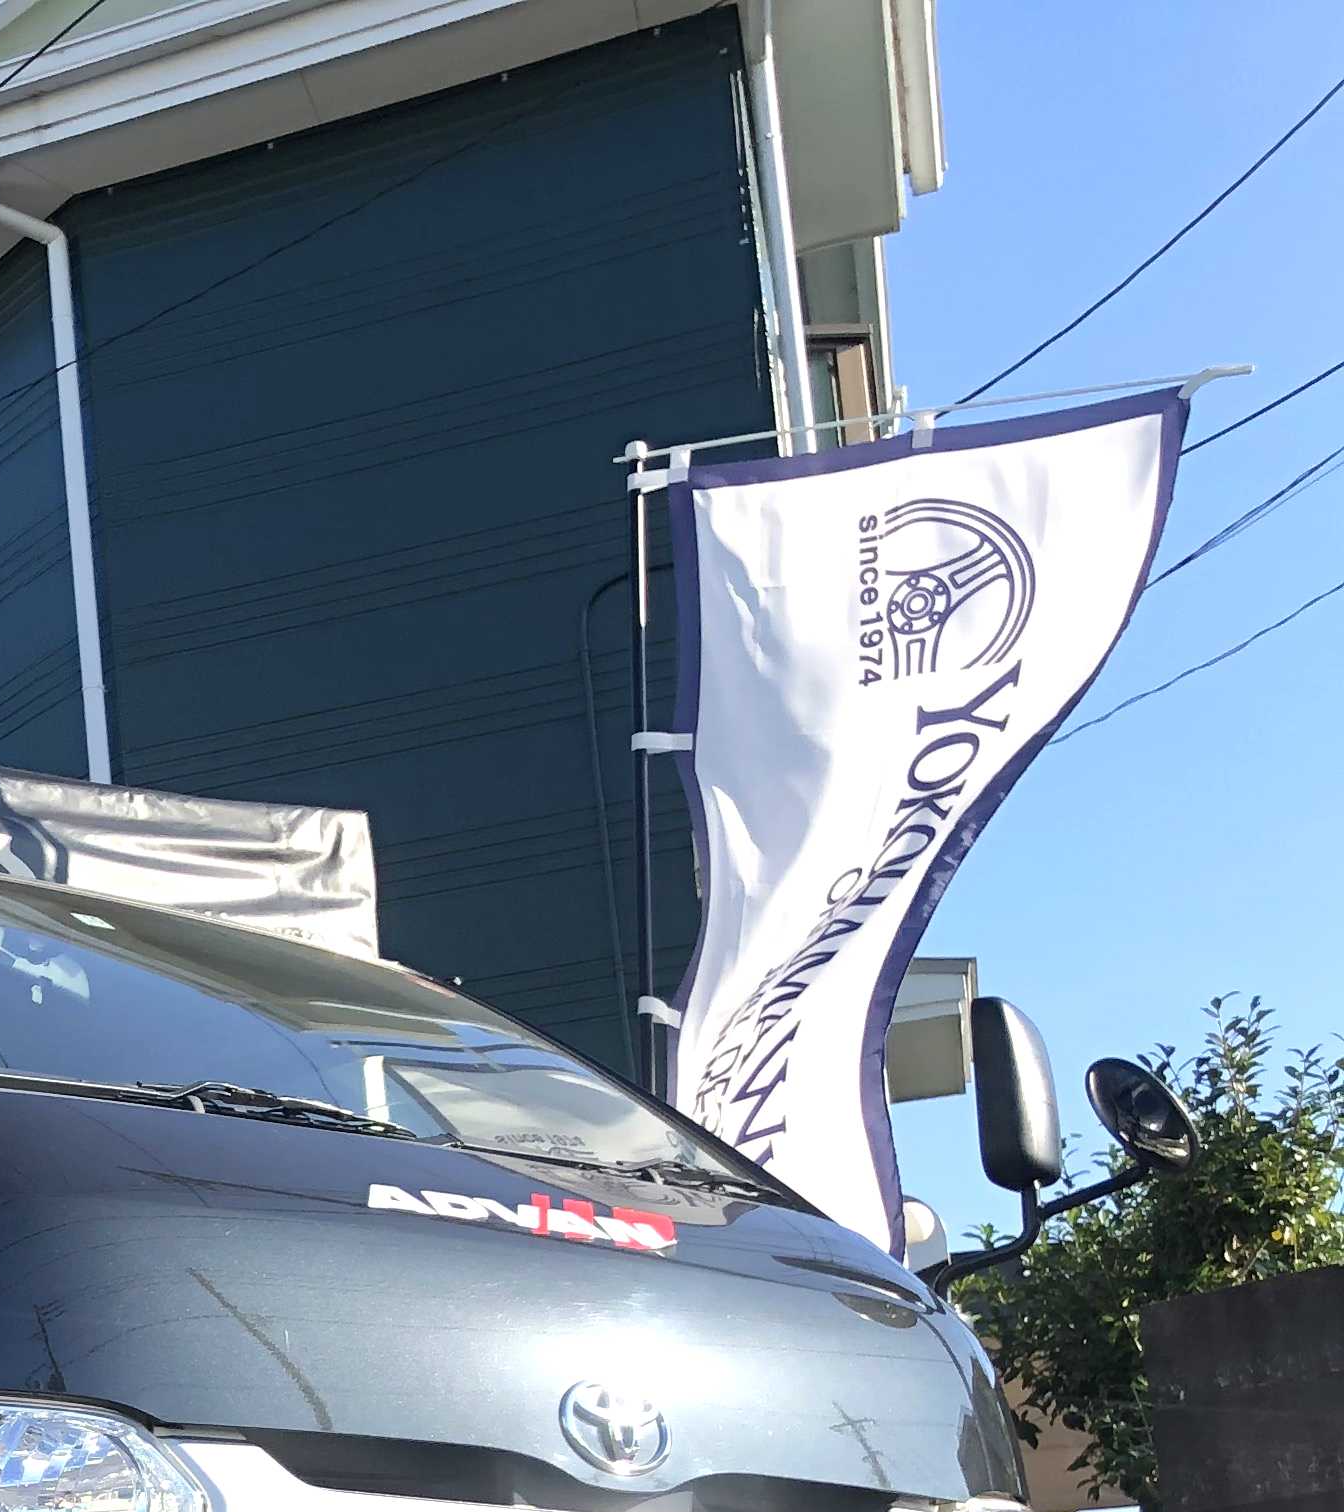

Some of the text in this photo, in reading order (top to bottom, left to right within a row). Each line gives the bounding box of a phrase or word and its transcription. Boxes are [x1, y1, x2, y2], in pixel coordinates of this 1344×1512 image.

[859, 514, 884, 687] since 1974
[367, 1183, 678, 1252] ADVAN
